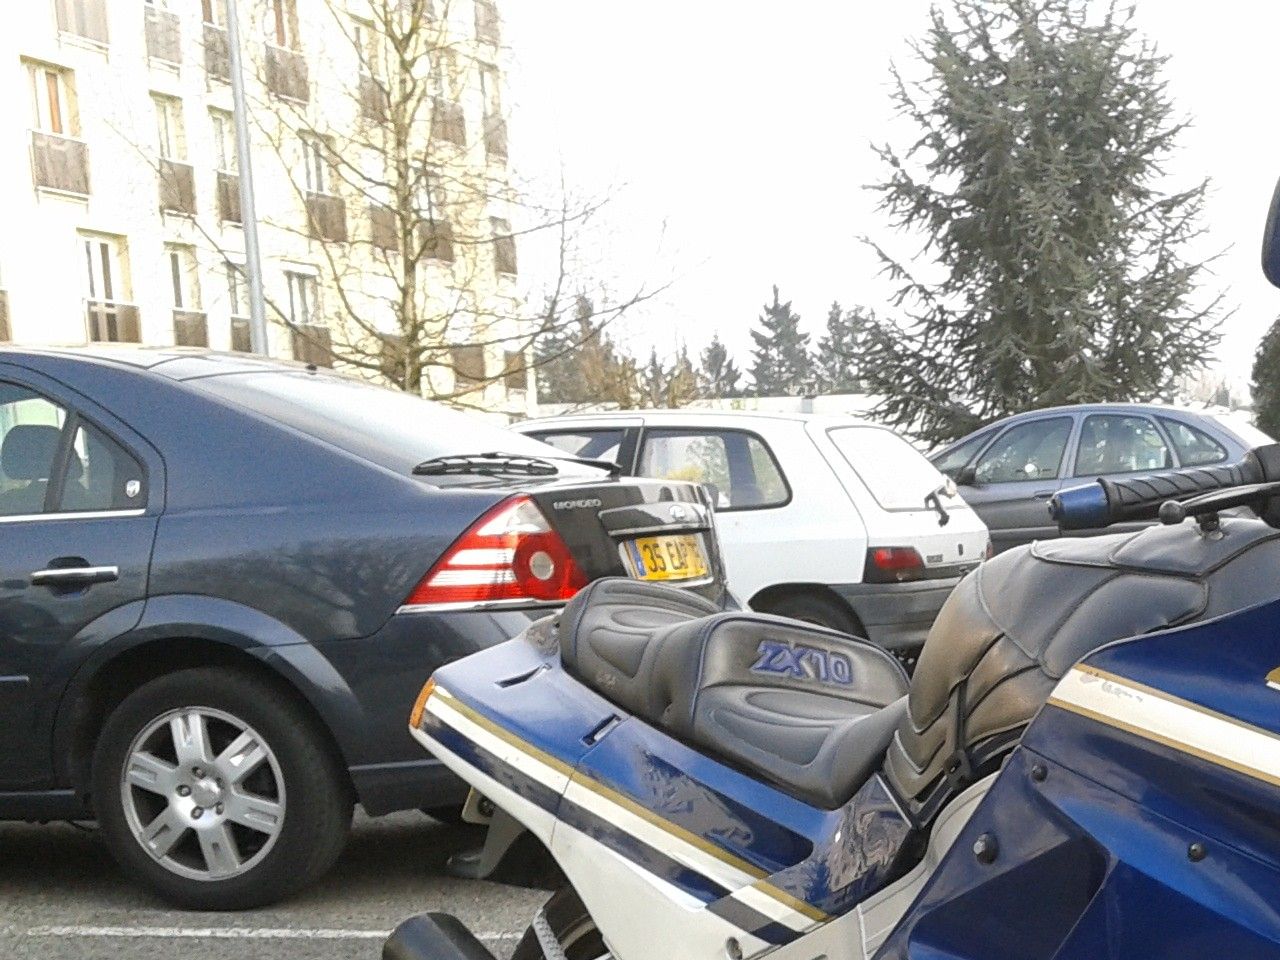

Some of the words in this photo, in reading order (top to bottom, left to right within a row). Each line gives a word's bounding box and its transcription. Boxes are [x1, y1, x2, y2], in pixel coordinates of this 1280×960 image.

[553, 499, 602, 510] MONDEO
[643, 543, 667, 572] 35
[750, 639, 854, 687] ZX10
